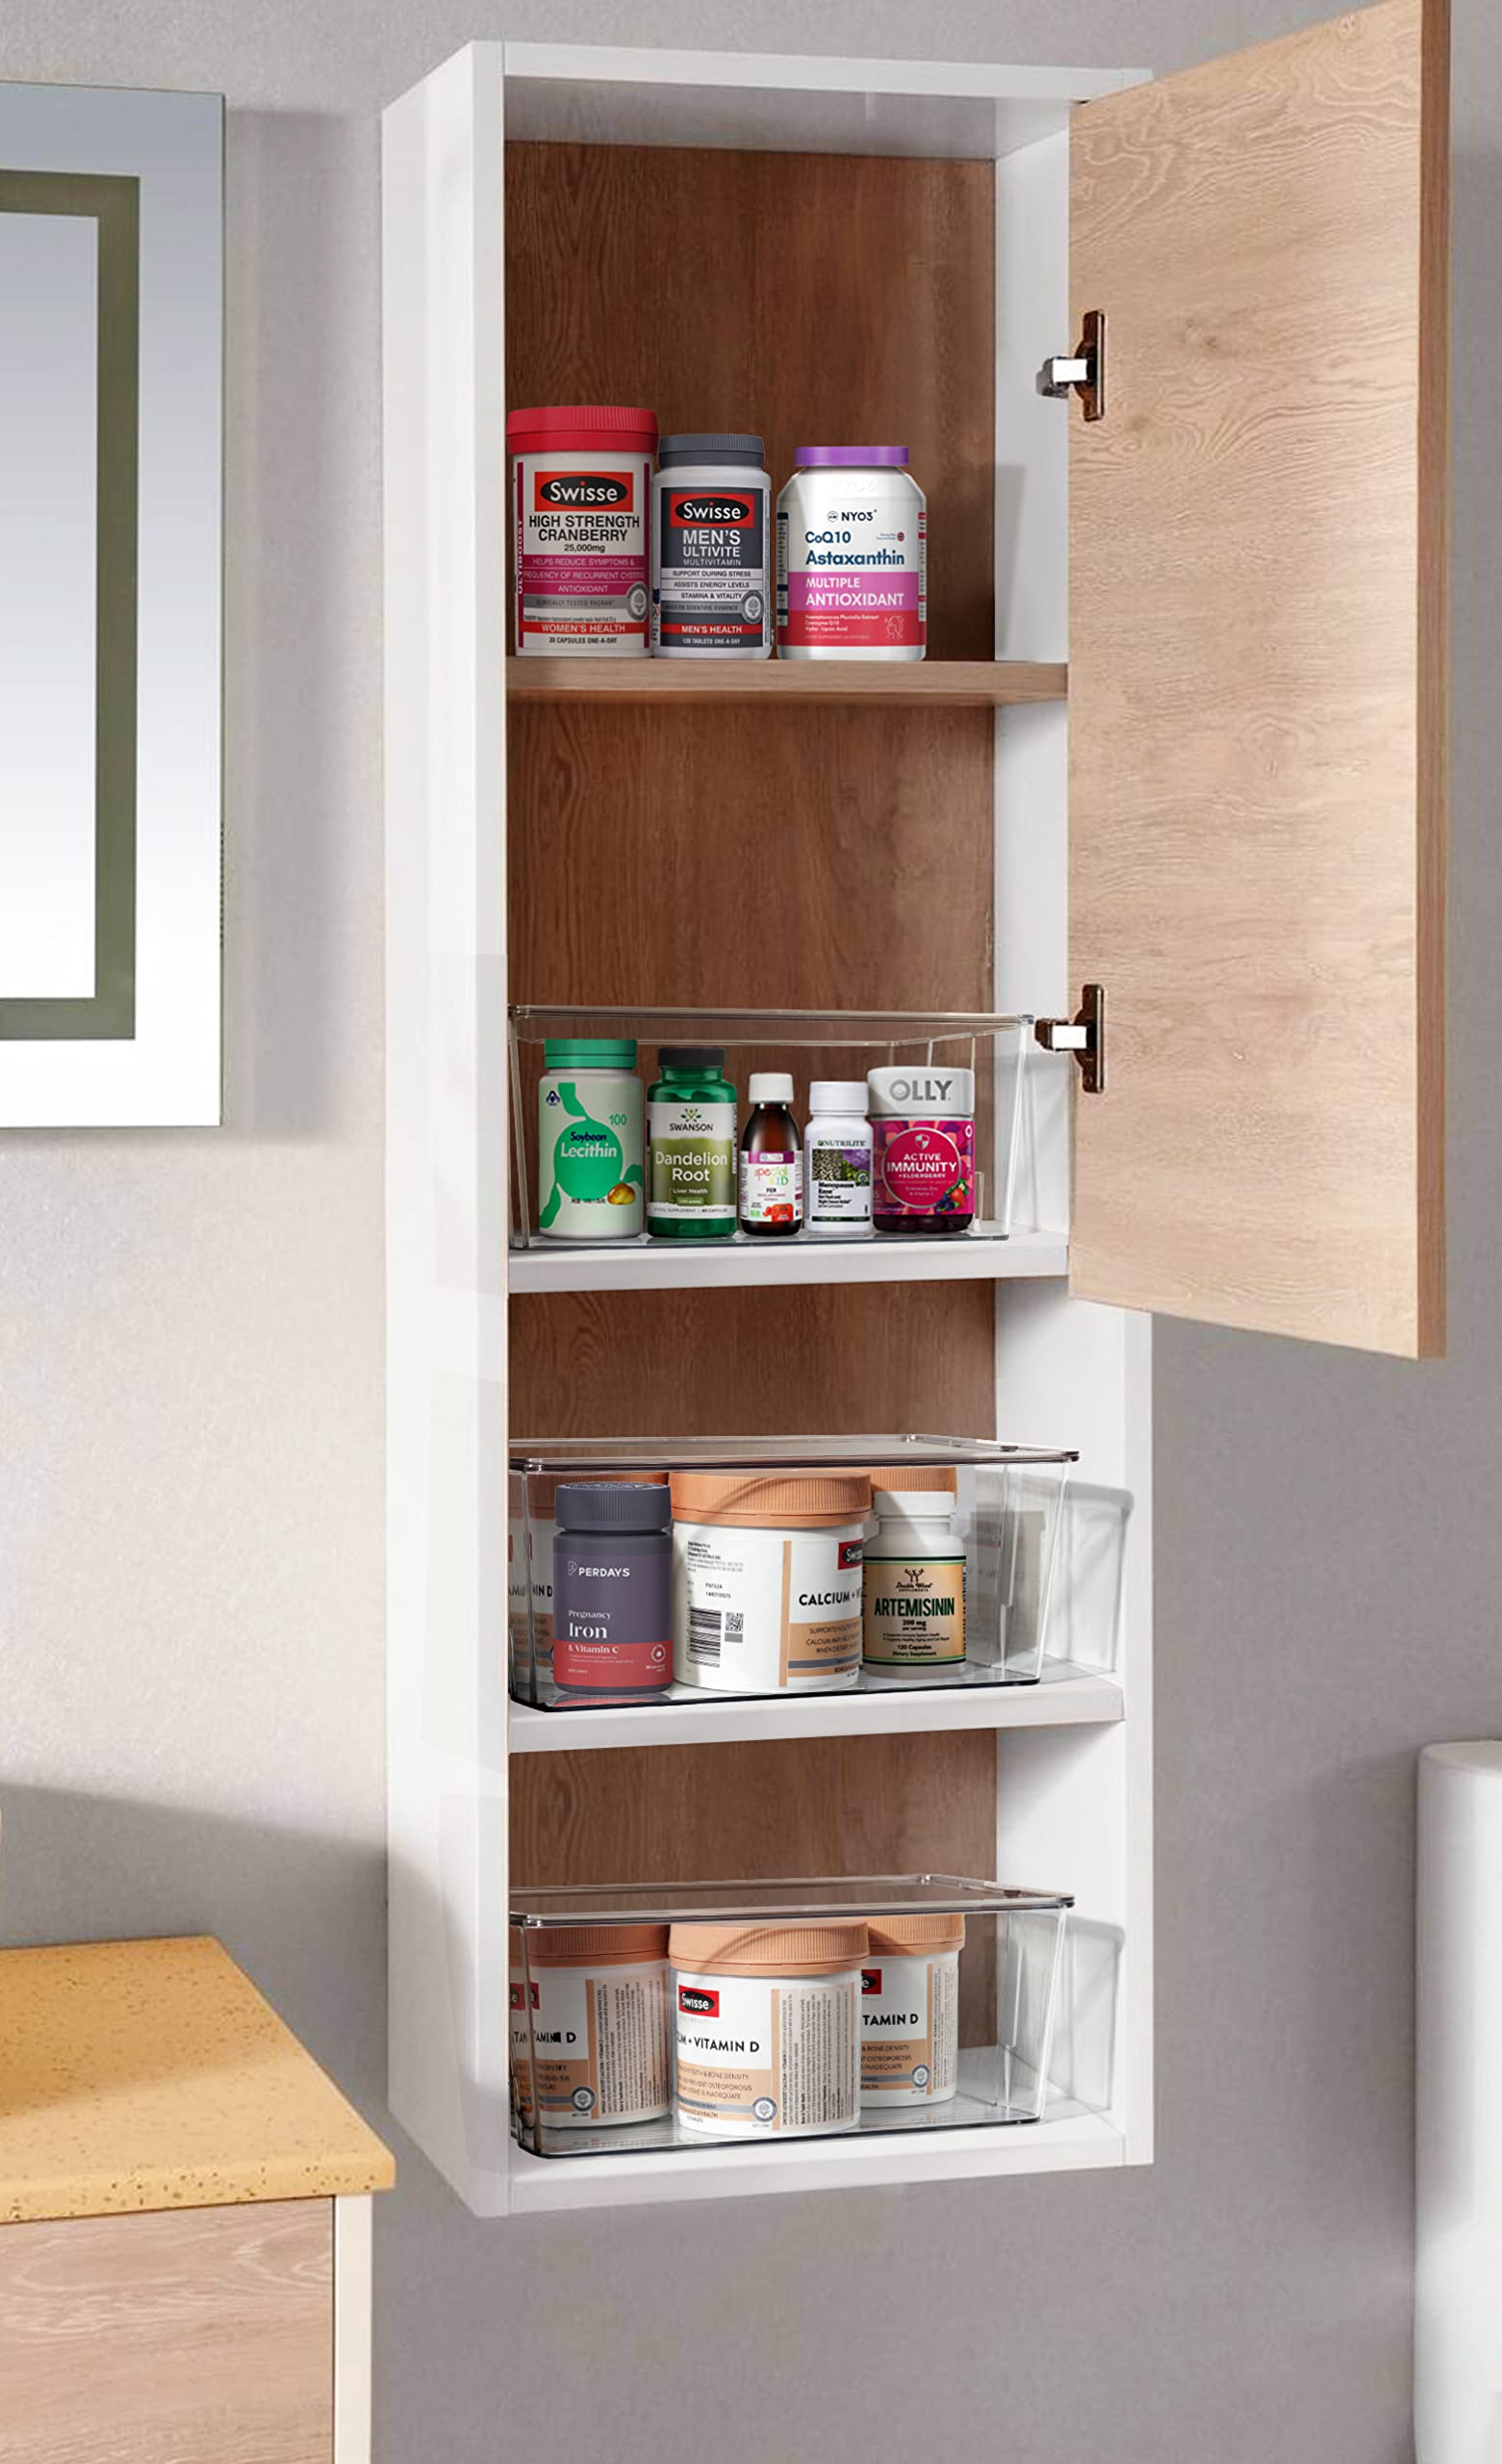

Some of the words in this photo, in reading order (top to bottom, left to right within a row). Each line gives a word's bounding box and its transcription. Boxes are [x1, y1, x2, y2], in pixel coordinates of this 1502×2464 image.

[549, 480, 618, 501] Swisse
[683, 502, 741, 519] Swisse
[529, 515, 560, 528] HIGH
[566, 515, 640, 528] STRENGTH
[538, 529, 627, 542] CRANBERRY
[683, 529, 741, 545] MEN'S
[804, 531, 852, 544] CoQ10
[564, 543, 605, 553] 25,000mg
[683, 546, 741, 557] ULTIVITE
[805, 549, 904, 566] Astaxanthin
[805, 578, 861, 588] MULTIPLE
[805, 593, 904, 606] ANTIOXIDANT
[542, 624, 587, 632] WOMEN'S
[589, 624, 626, 633] HEALTH
[889, 1079, 953, 1101] OLLY
[608, 1114, 627, 1125] 100
[670, 1123, 714, 1132] SWANSON
[570, 1131, 607, 1143] Soybean
[561, 1142, 617, 1158] Lecithin
[654, 1151, 727, 1167] Dandelion
[886, 1162, 957, 1173] IMMUNITY
[672, 1168, 711, 1182] Root
[578, 1567, 630, 1578] PERDAYS
[799, 1590, 851, 1606] CALCIUM
[874, 1597, 955, 1617] ARTEMISININ
[568, 1609, 612, 1621] Pregnancy
[569, 1622, 608, 1639] Iron
[574, 1644, 610, 1655] Vitamin
[612, 1646, 621, 1655] C
[681, 1992, 709, 2011] Swisse
[862, 2014, 906, 2026] TAMIN
[909, 2013, 919, 2025] D
[566, 2032, 576, 2043] D
[694, 2036, 745, 2052] VITAMIN
[750, 2040, 760, 2053] D
[708, 2081, 752, 2092] OSTEOPOROSIS
[706, 2091, 742, 2100] INADEQUATE
